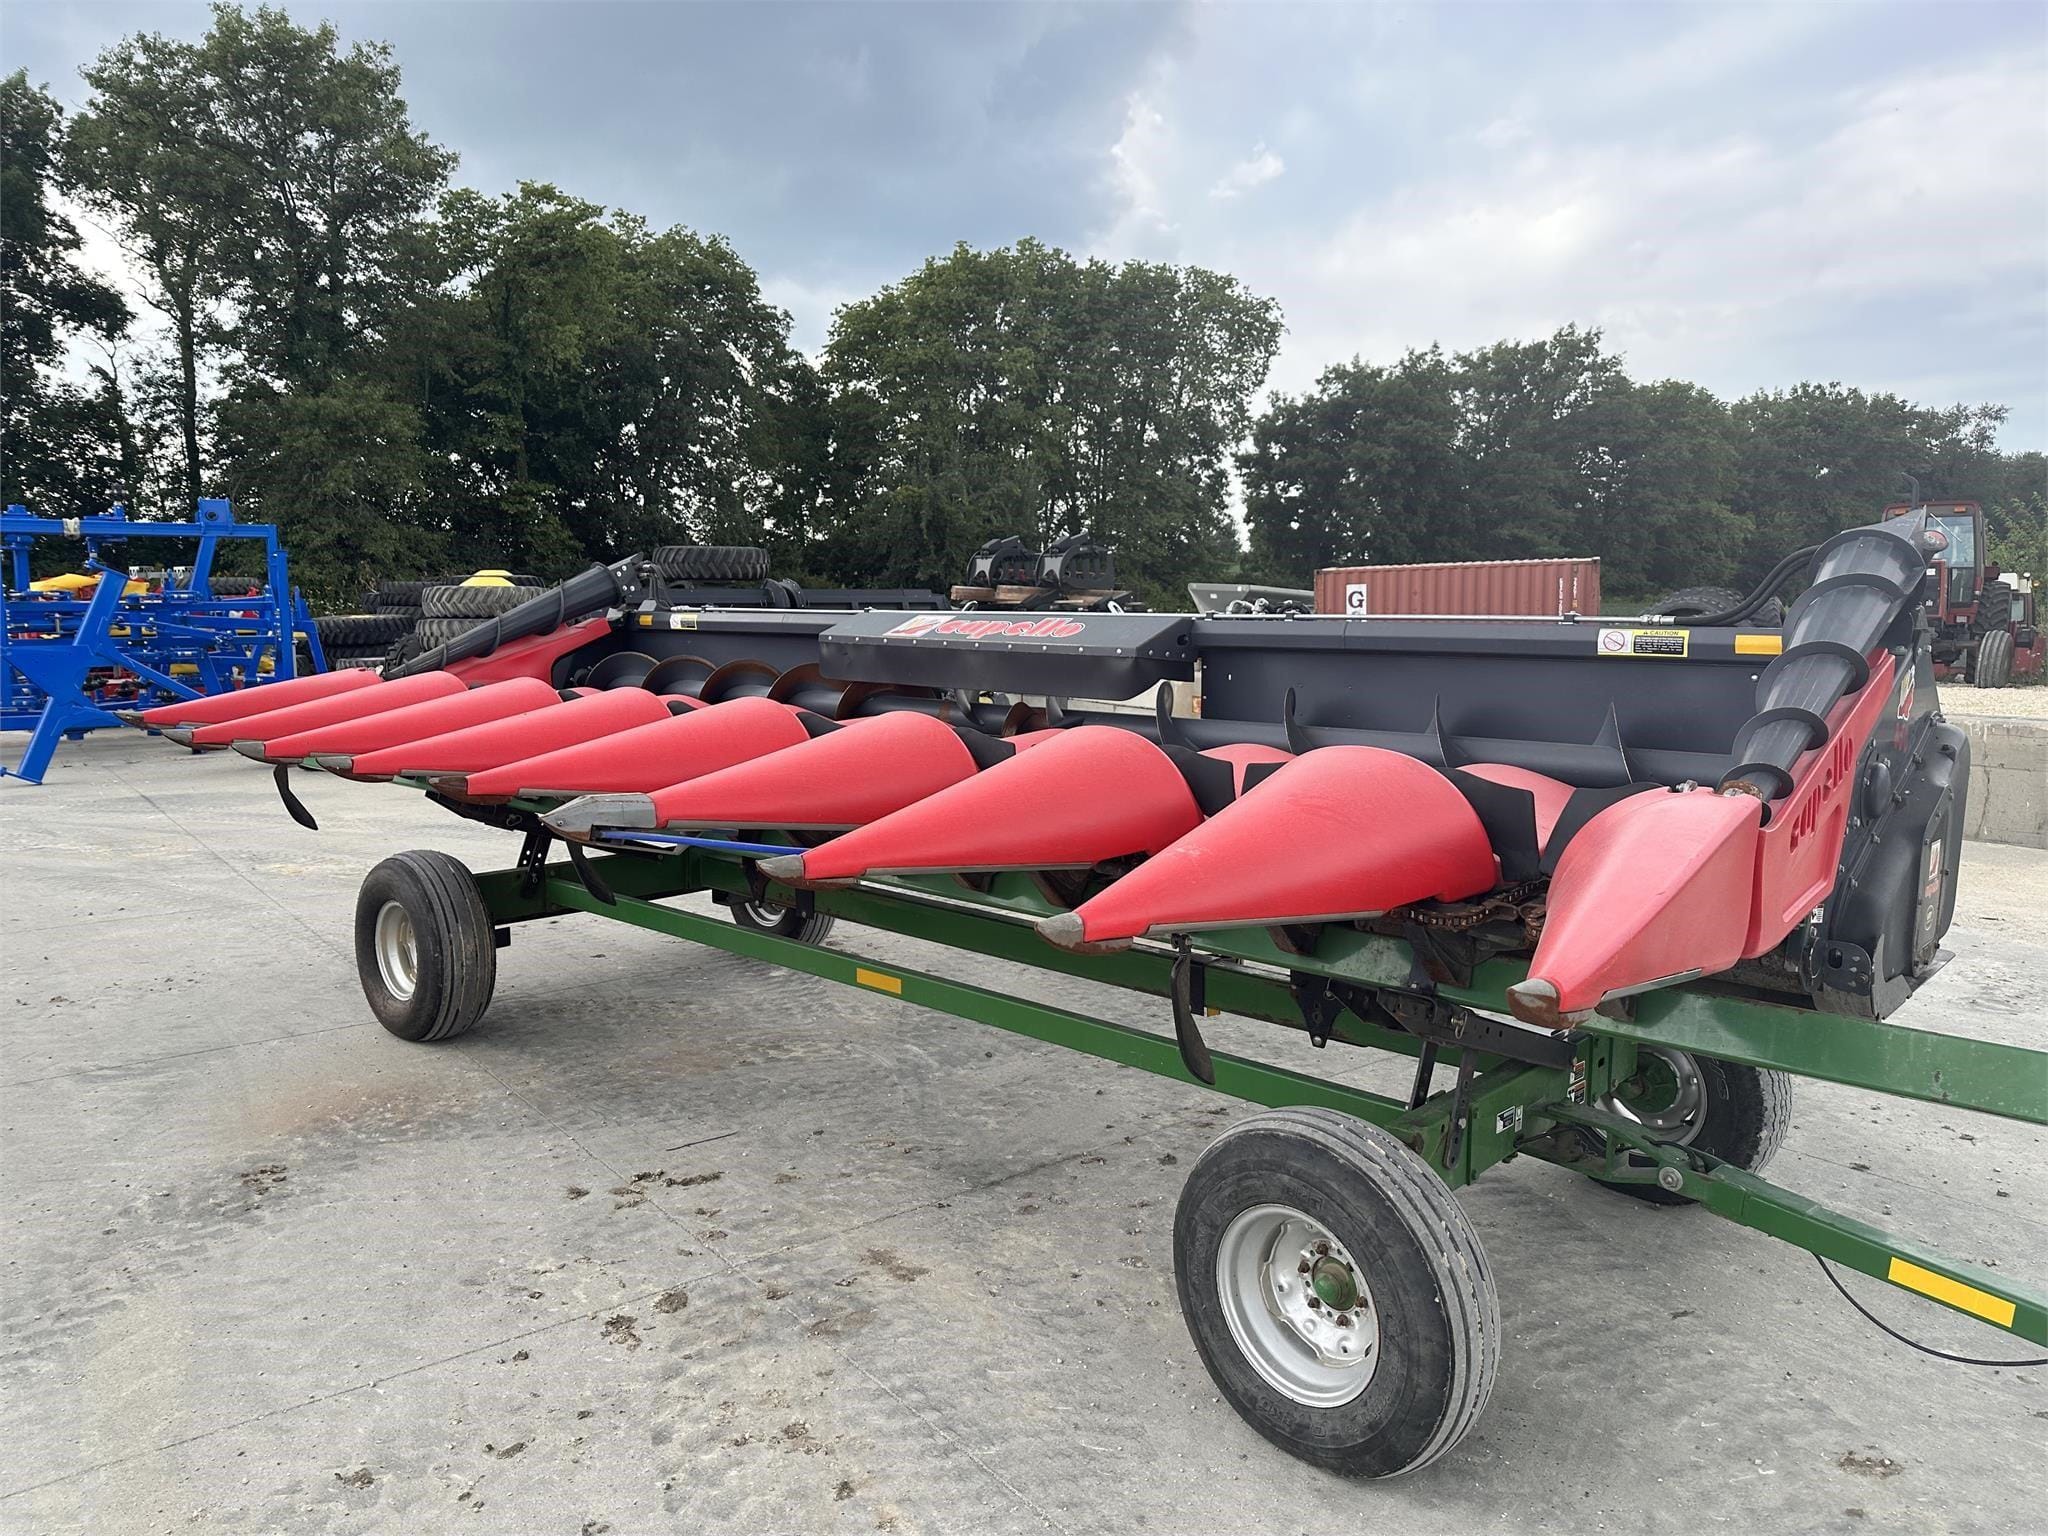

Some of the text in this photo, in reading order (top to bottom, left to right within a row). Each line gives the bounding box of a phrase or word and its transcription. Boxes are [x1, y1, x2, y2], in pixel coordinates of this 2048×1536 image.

[1348, 591, 1365, 608] G
[935, 617, 1085, 639] capello
[1790, 736, 1853, 853] capello
